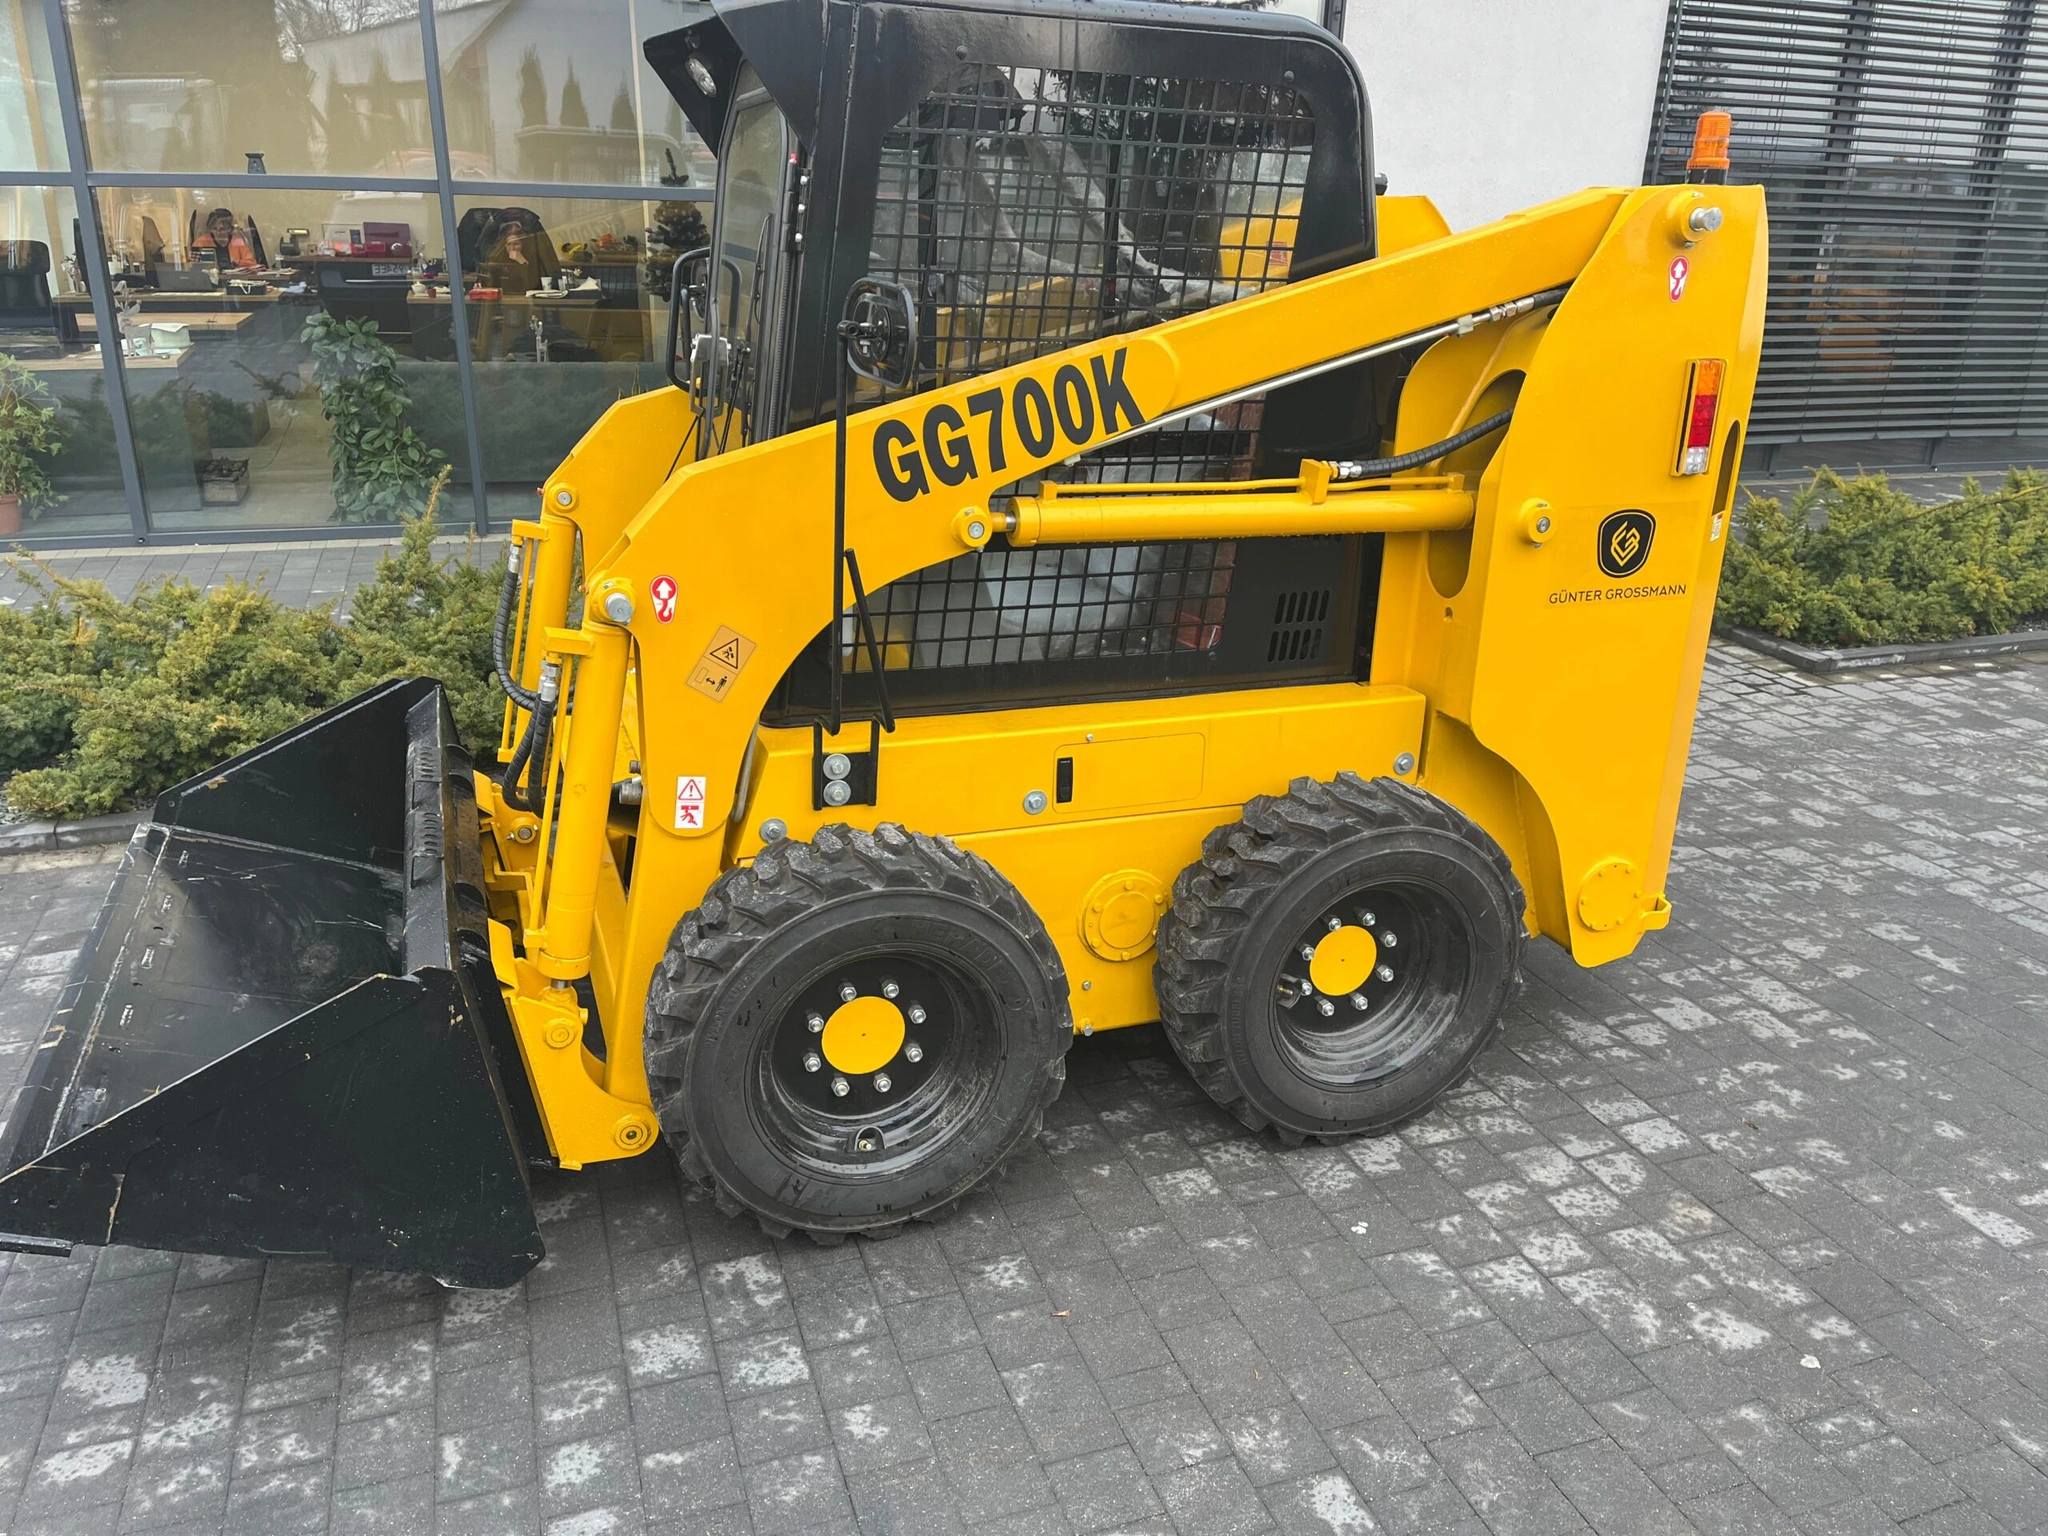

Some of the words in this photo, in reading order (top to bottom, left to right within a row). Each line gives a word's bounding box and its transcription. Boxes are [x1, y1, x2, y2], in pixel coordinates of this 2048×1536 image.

[873, 347, 1146, 502] GG700K
[1549, 589, 1602, 604] GÜNTER
[1605, 584, 1687, 600] GROSSMANN
